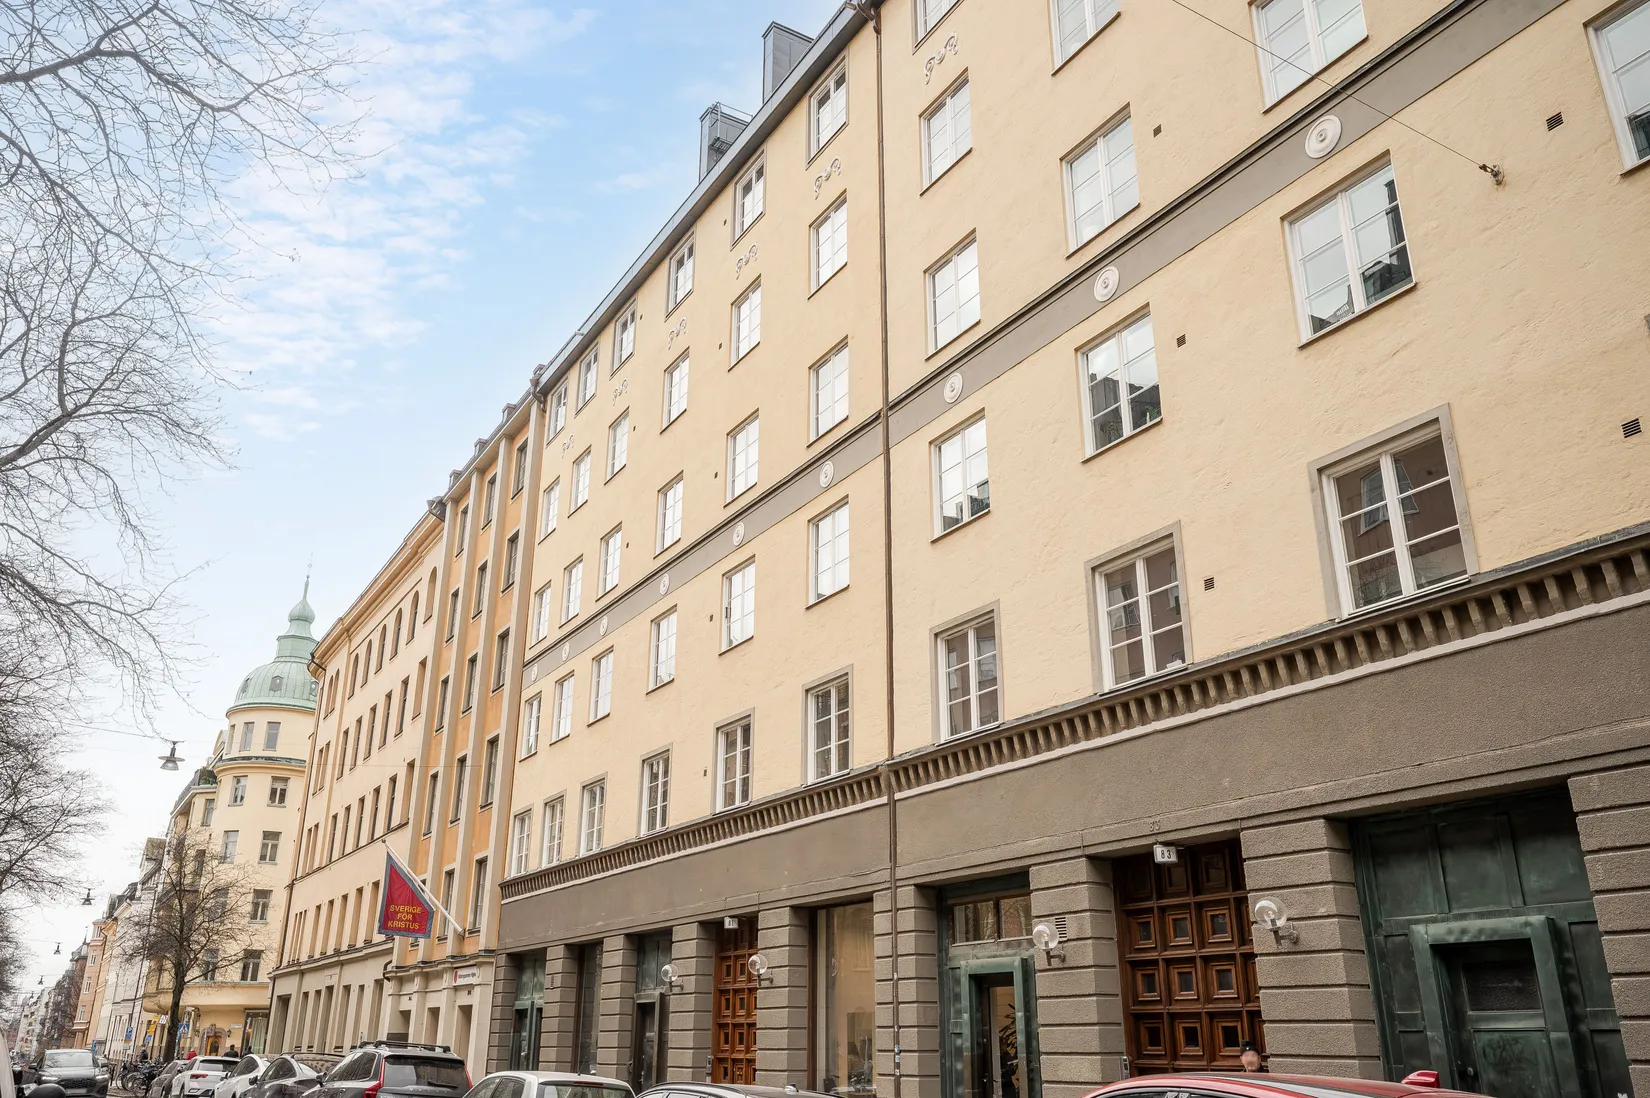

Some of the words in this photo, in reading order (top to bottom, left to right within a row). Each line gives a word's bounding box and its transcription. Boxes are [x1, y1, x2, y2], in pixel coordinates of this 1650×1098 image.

[1160, 849, 1172, 859] 83
[390, 904, 422, 913] SVERIGE
[397, 912, 413, 920] FÖR
[388, 920, 419, 929] KRISTUS
